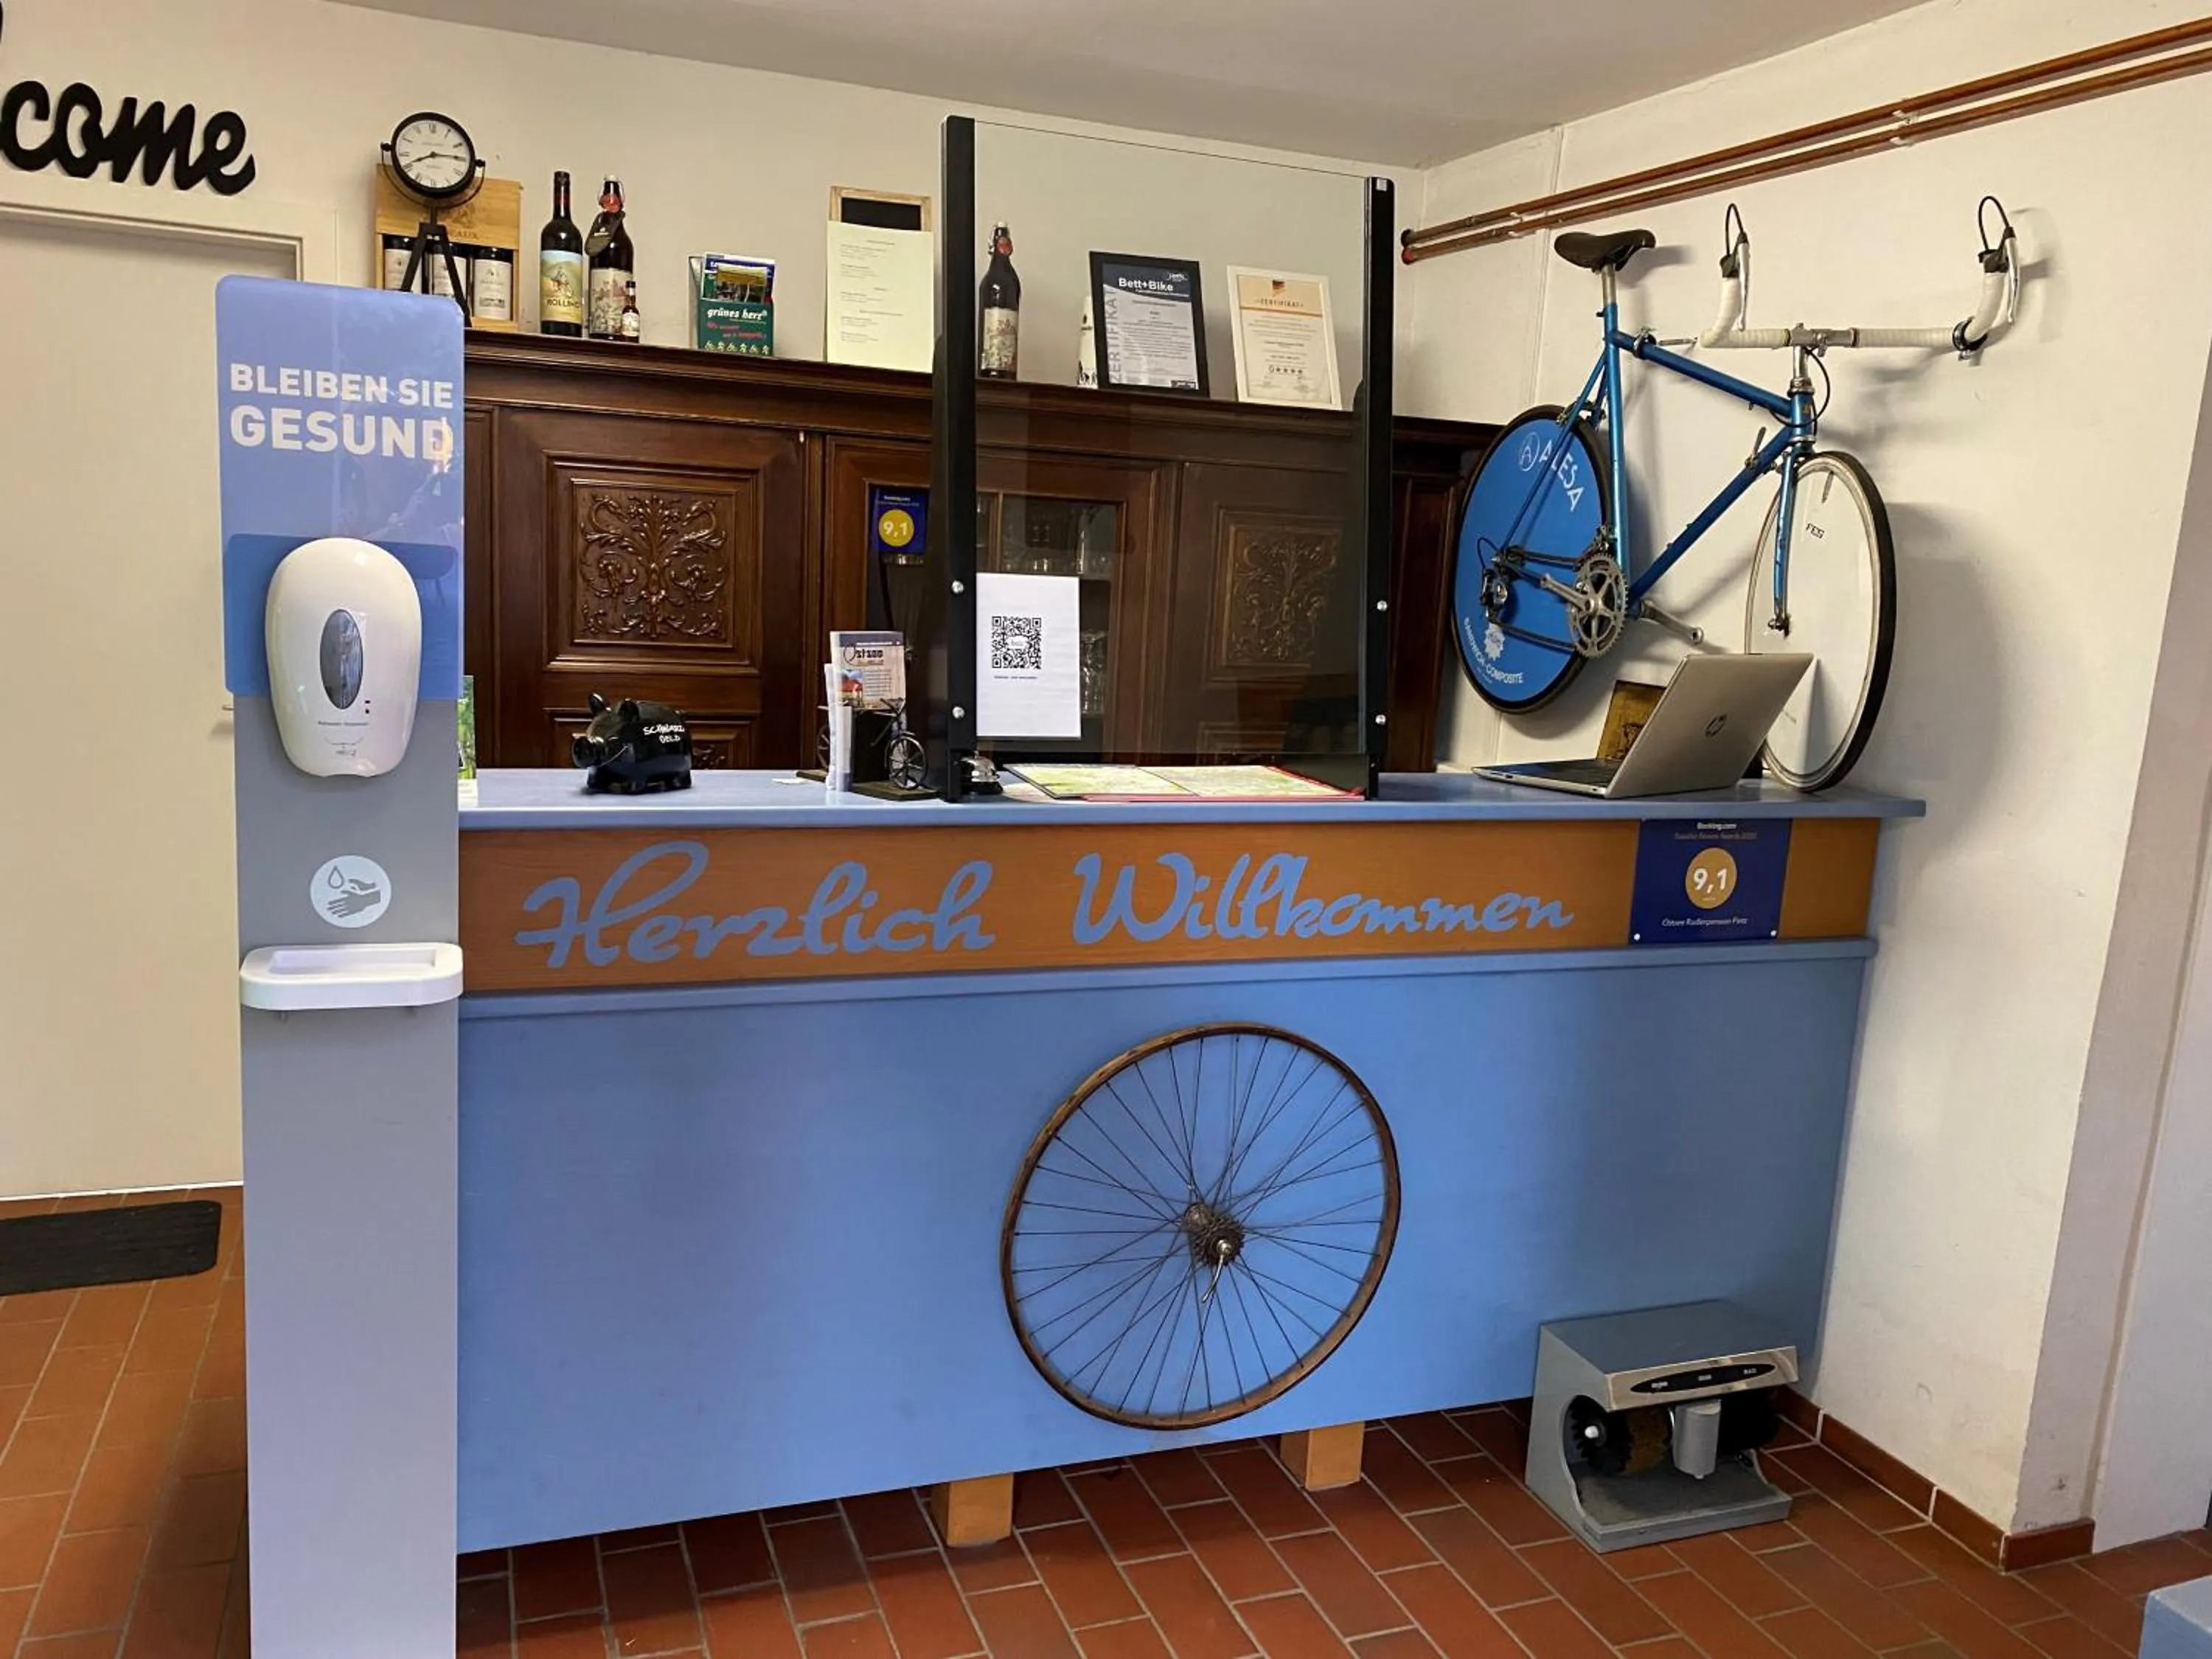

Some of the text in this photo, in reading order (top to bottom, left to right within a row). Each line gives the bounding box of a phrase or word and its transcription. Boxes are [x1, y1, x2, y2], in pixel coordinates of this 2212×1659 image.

[0, 80, 256, 196] come
[1119, 276, 1174, 292] Bett+Bike
[231, 364, 453, 408] BLEIBEN SIE
[231, 405, 453, 460] GESUND
[515, 841, 1573, 968] Herzlich Willkommen
[1693, 867, 1728, 894] 9,1
